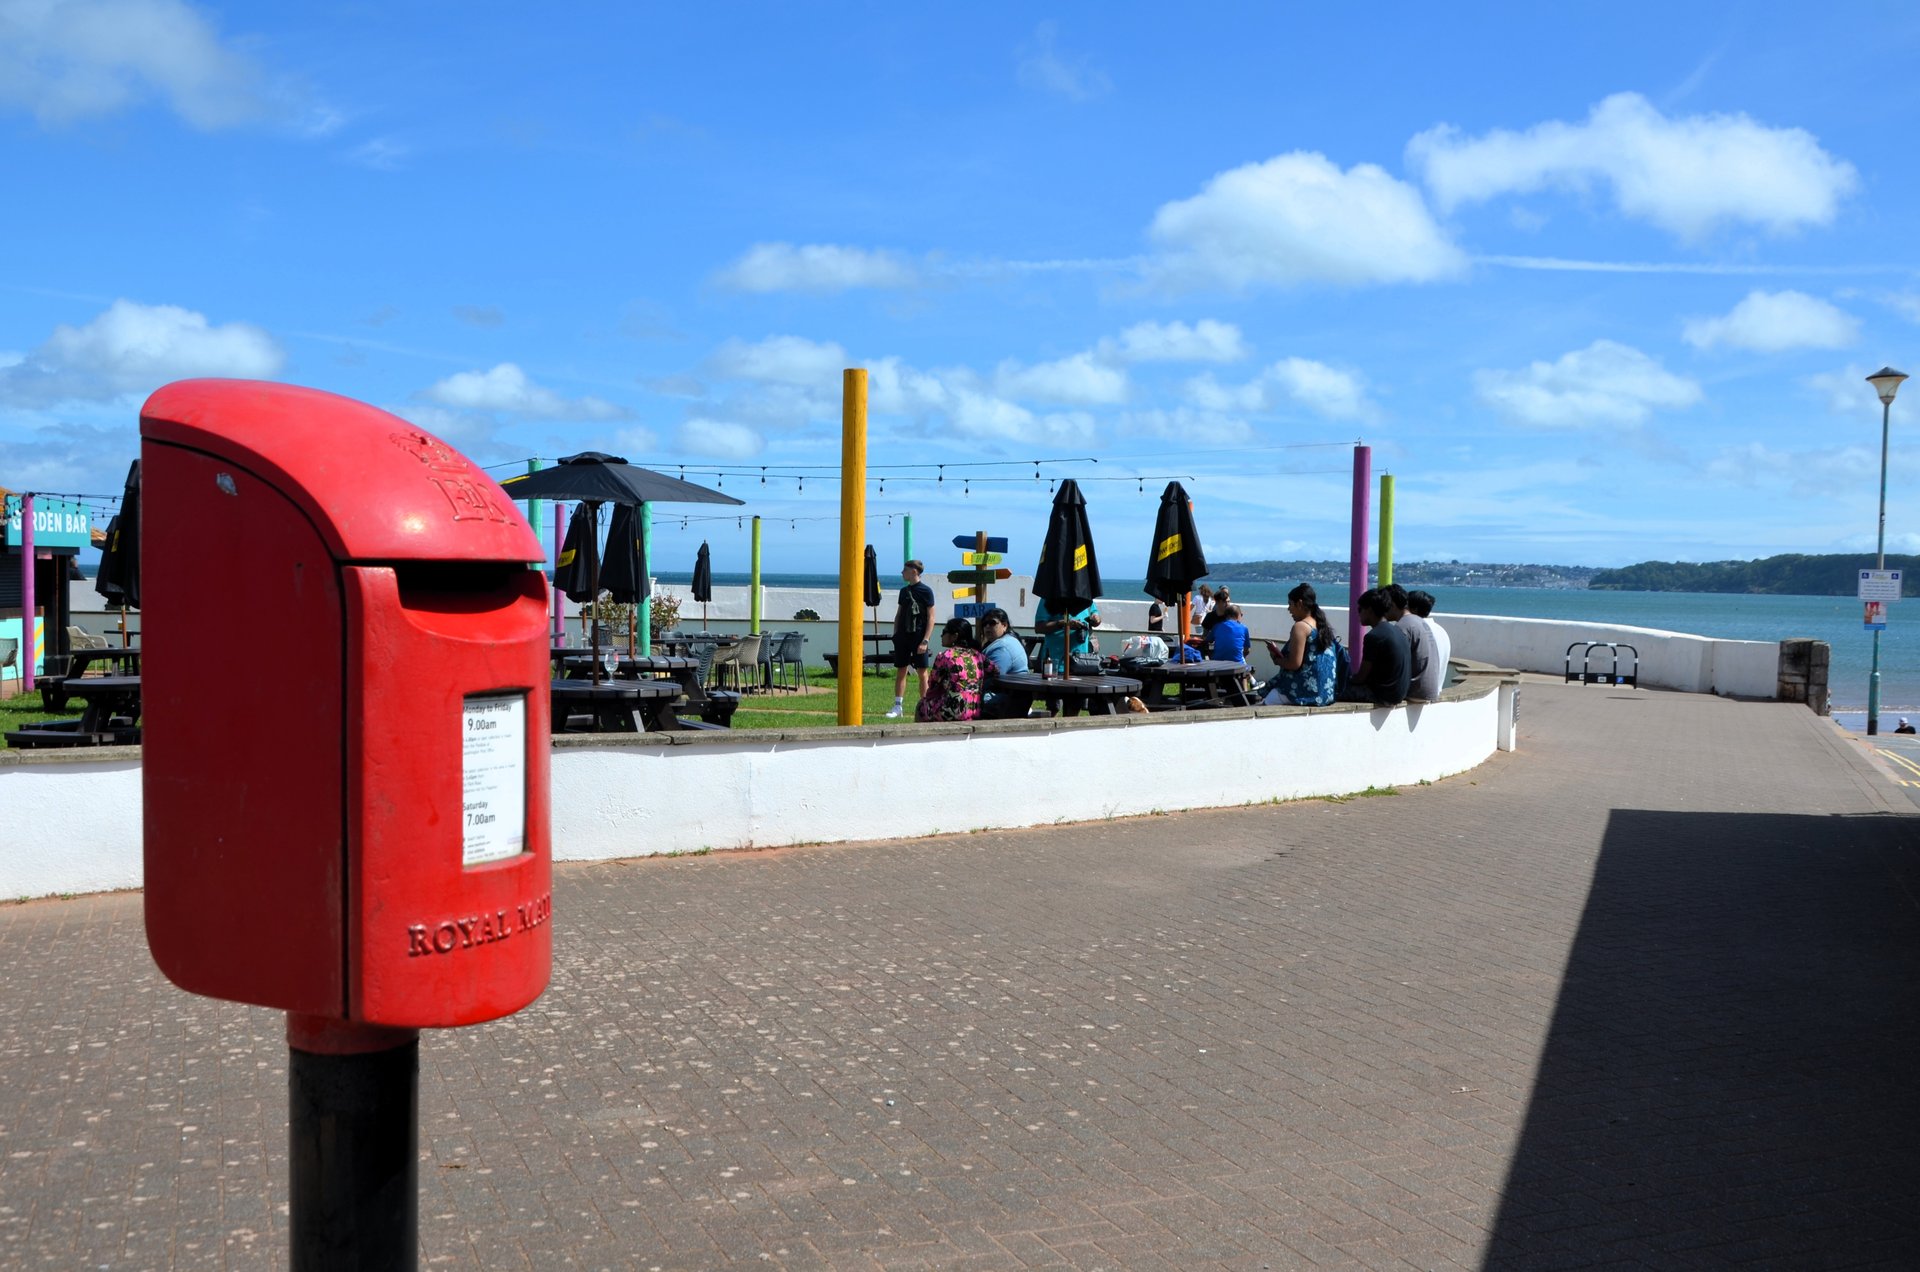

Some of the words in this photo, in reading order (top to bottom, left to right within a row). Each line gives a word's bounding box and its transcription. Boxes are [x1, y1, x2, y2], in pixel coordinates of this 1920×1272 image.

[12, 509, 62, 533] GRDEN
[65, 513, 88, 534] BAR
[963, 604, 985, 617] BAR
[487, 705, 493, 713] to
[495, 702, 512, 713] Friday
[468, 718, 497, 731] 9.00am
[463, 800, 488, 811] Saturday
[467, 813, 496, 827] 7.00am
[408, 910, 511, 957] ROYAL
